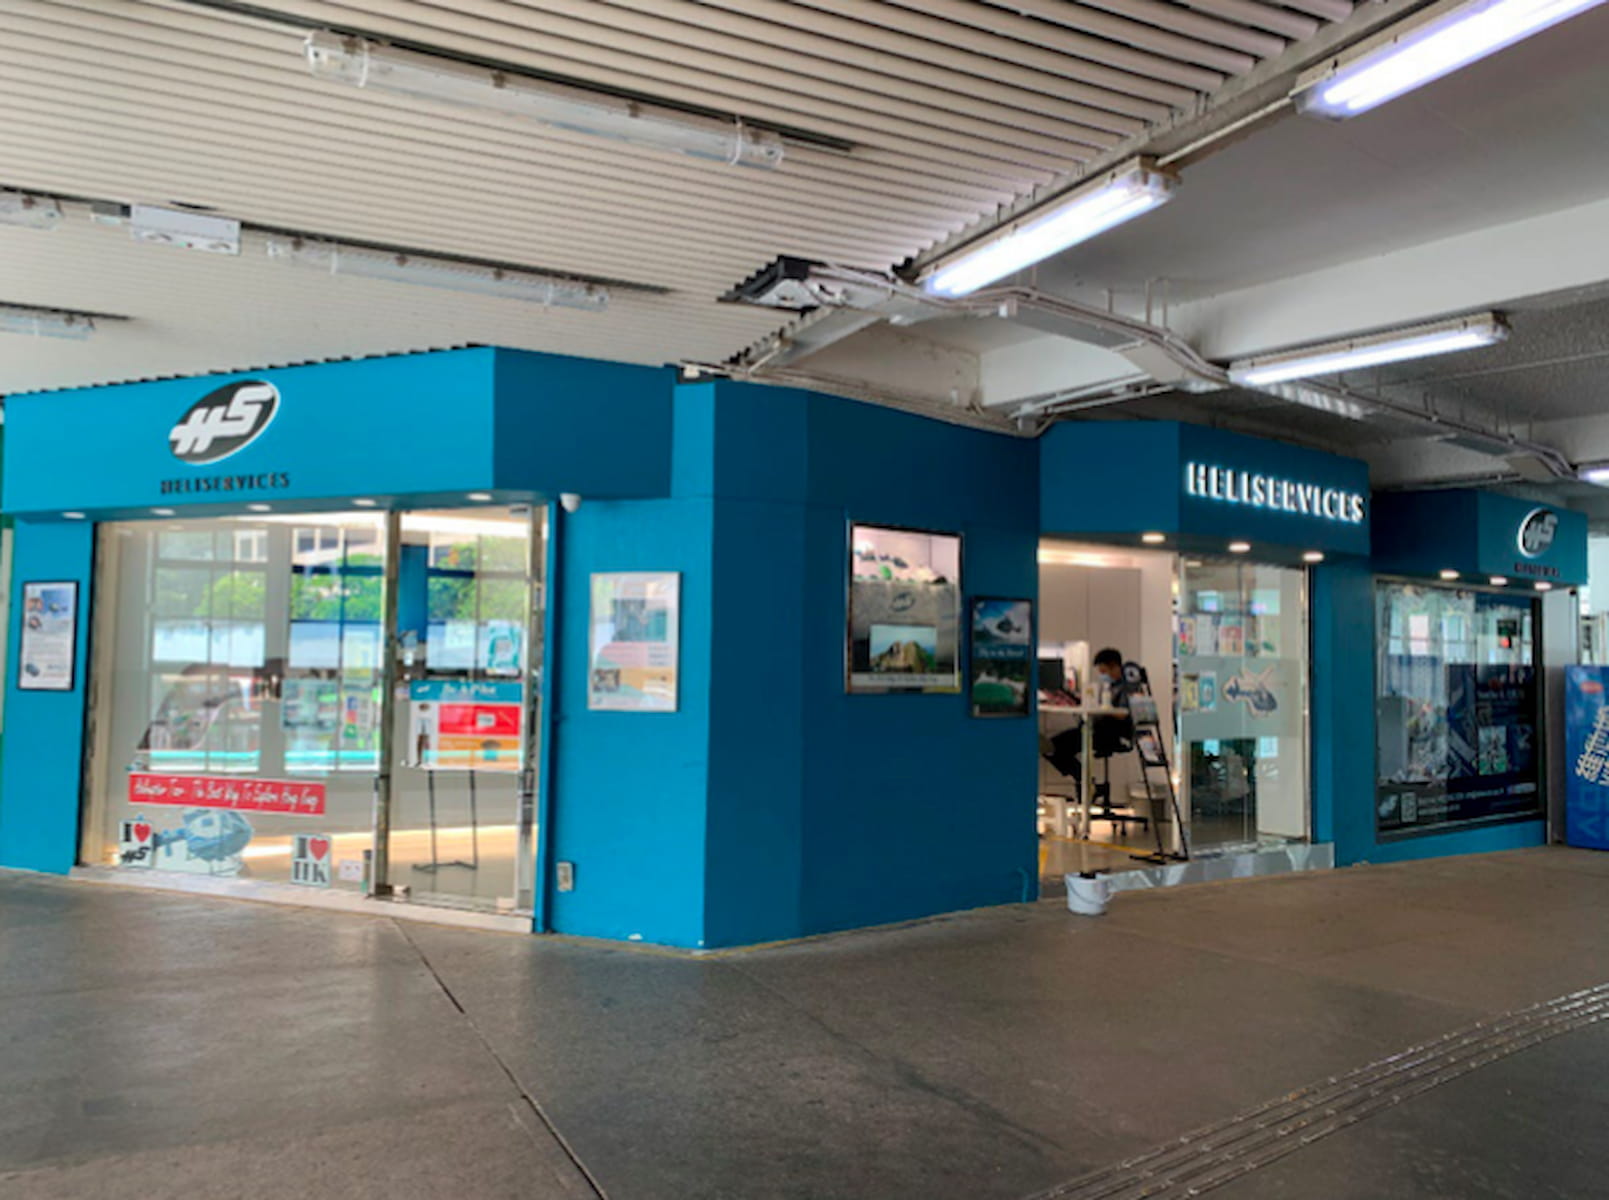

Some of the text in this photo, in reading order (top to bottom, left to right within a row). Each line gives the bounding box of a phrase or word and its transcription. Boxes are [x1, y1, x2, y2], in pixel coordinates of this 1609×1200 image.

[160, 472, 290, 495] HELISERVICES
[1186, 461, 1366, 524] HELISERVICES
[123, 823, 132, 843] I
[296, 837, 307, 859] I
[293, 860, 327, 883] HK
